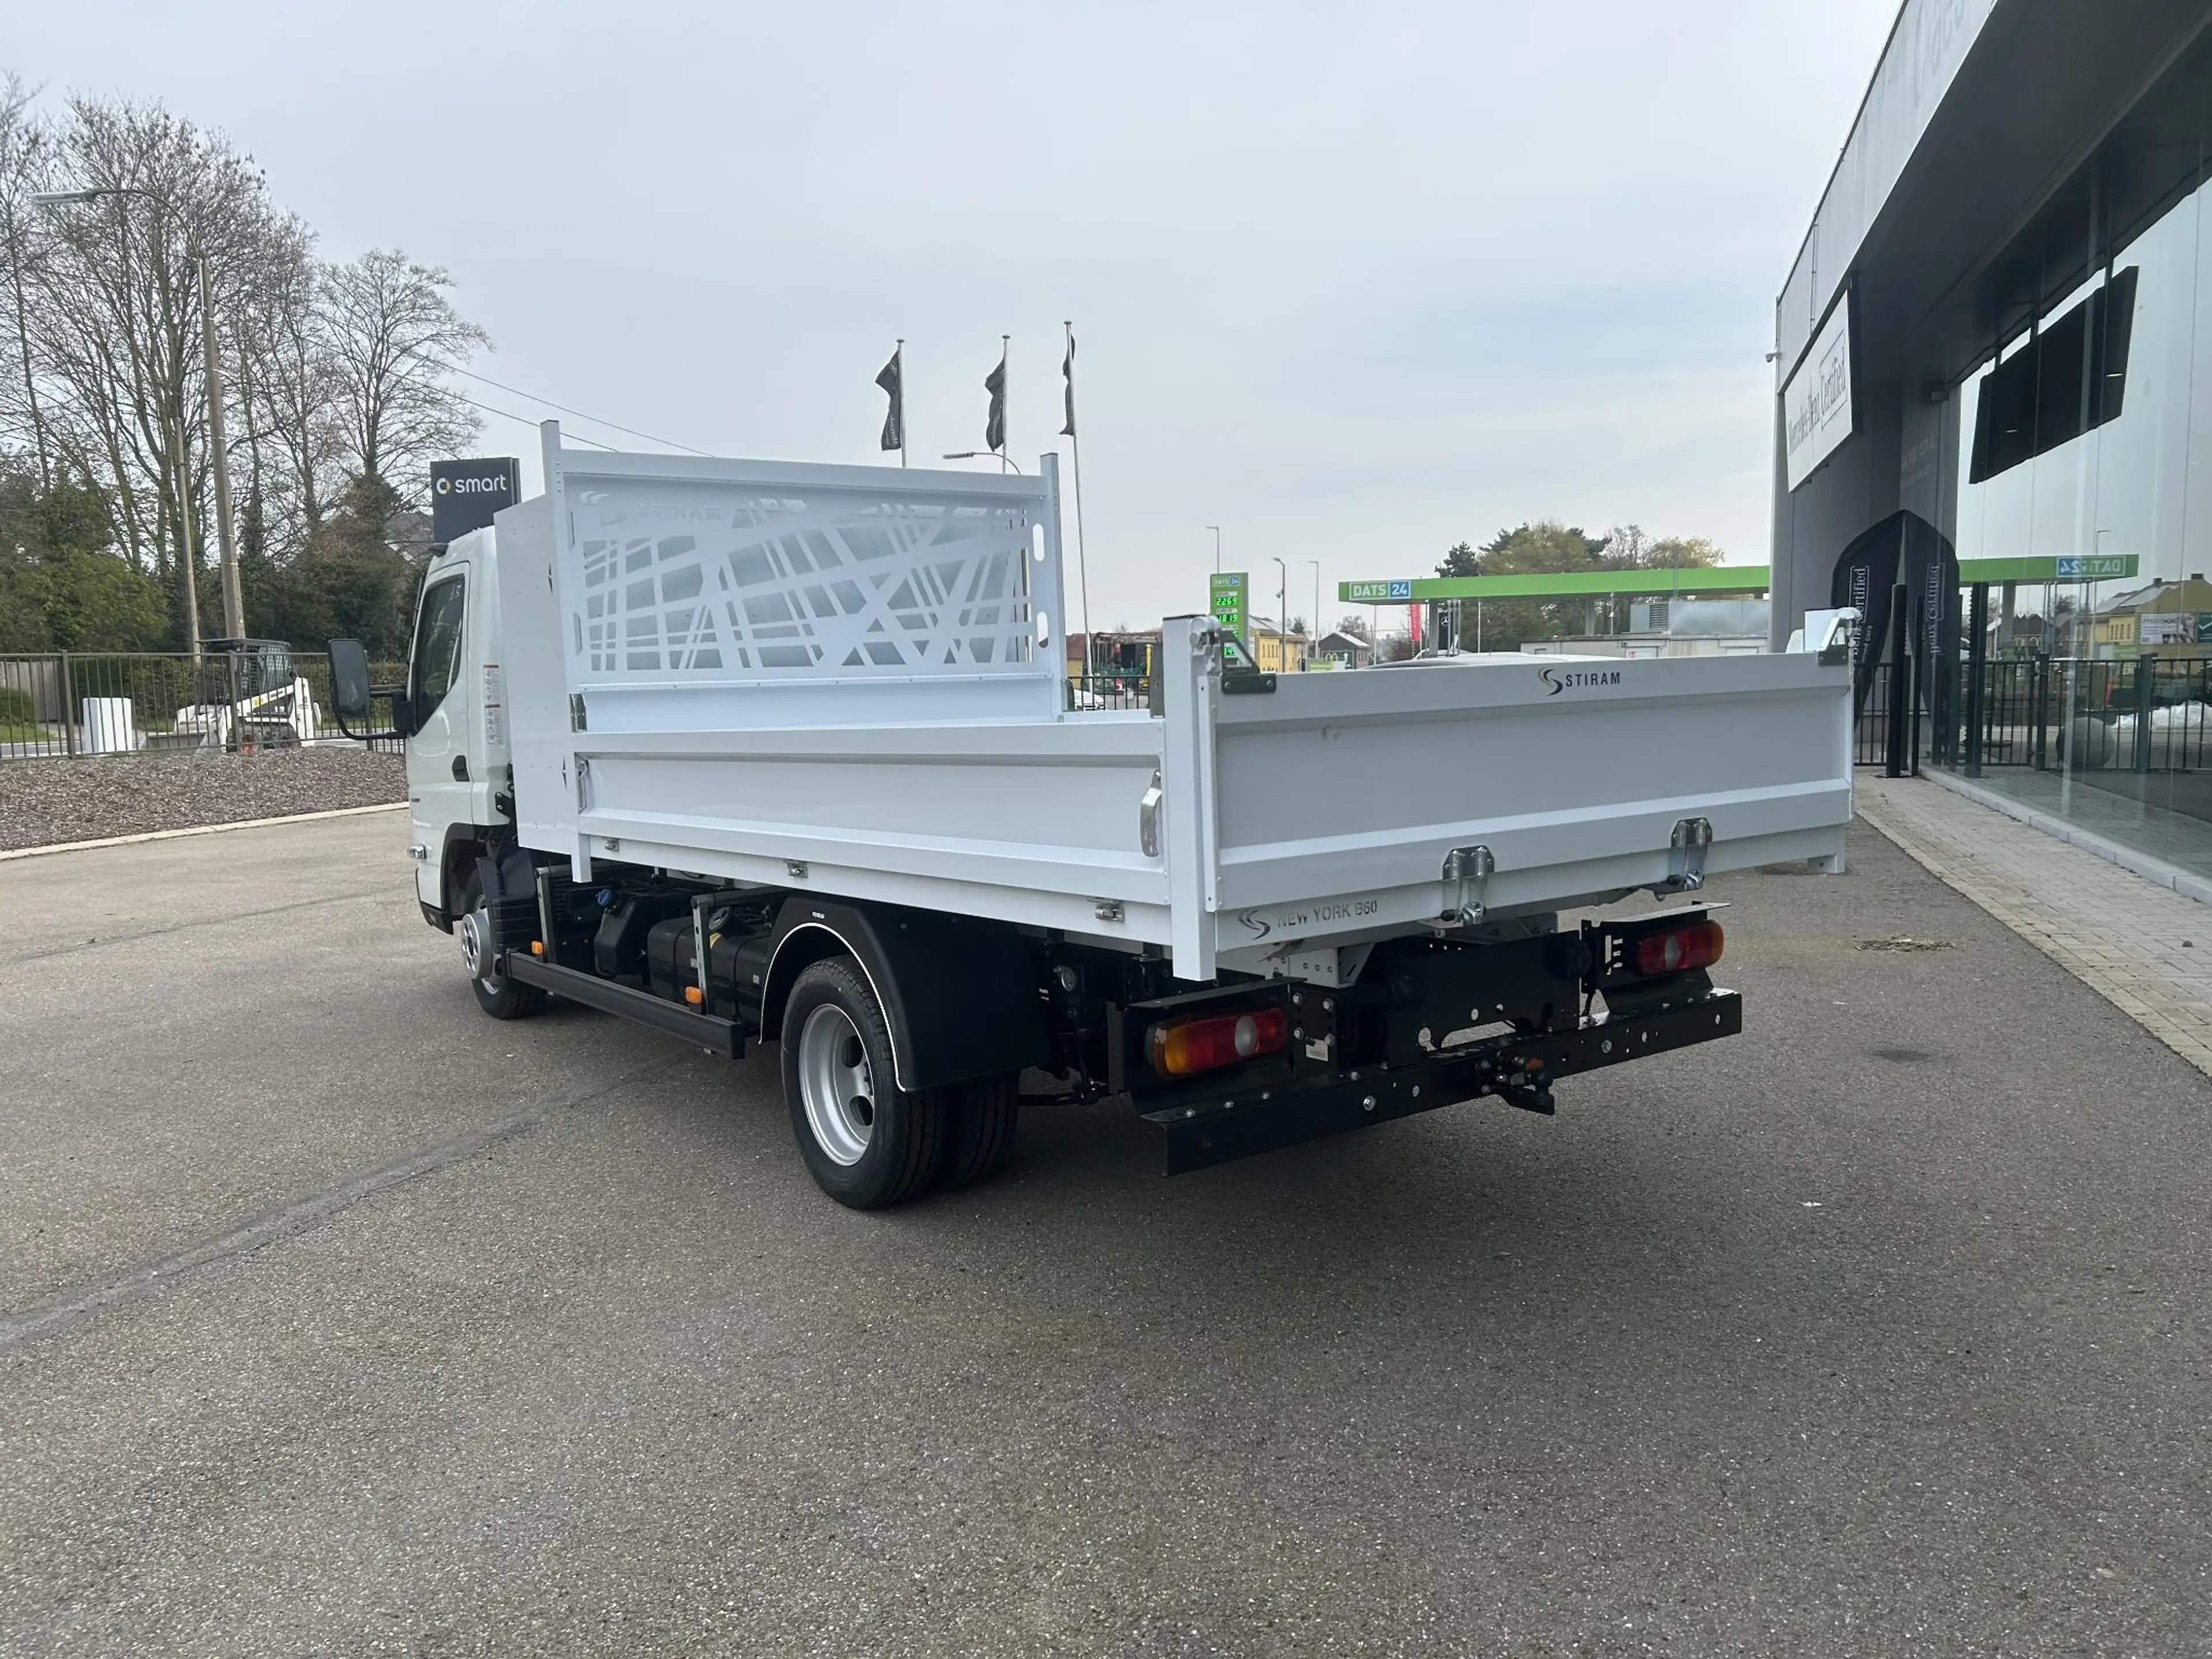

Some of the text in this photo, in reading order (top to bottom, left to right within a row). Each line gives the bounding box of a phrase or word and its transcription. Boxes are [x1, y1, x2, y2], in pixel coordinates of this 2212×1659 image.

[455, 474, 507, 494] smart
[1354, 584, 1408, 597] DATS 24
[1566, 672, 1620, 687] STIRAM
[1313, 905, 1351, 922] YORK
